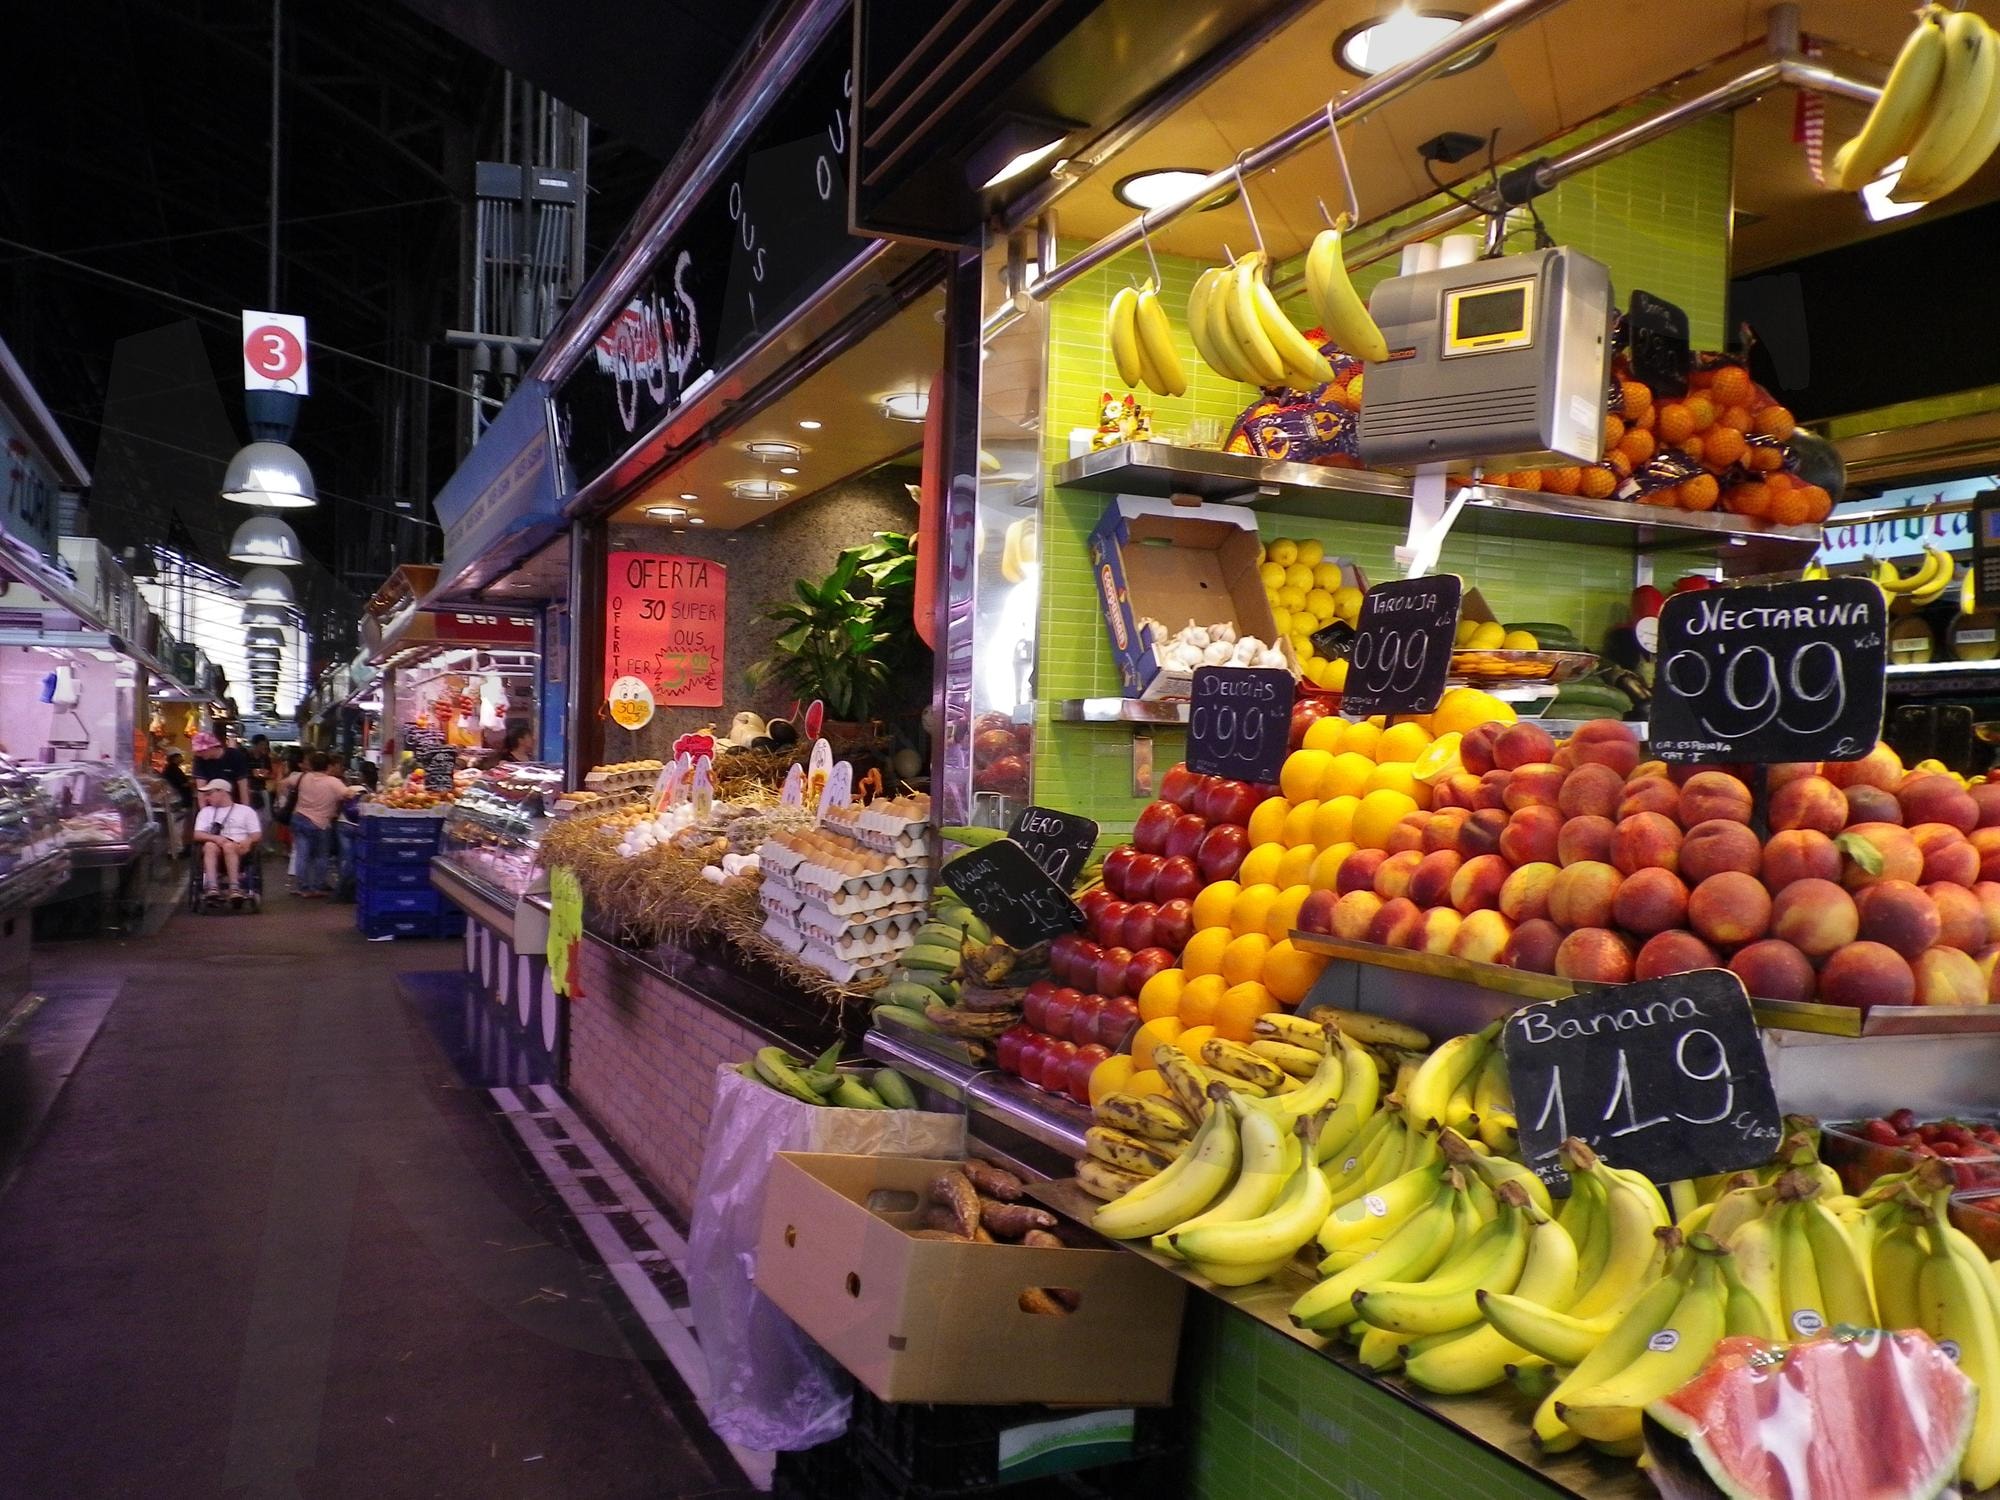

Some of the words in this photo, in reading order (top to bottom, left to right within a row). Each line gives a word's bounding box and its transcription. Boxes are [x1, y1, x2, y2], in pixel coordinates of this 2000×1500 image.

[262, 334, 287, 371] 3
[1822, 490, 1977, 552] ambla
[626, 559, 709, 589] OFERTA
[639, 598, 666, 620] 30
[671, 601, 717, 621] SUPER
[1369, 592, 1438, 614] TARONJA
[612, 596, 623, 679] OFERTA
[674, 629, 705, 646] OUS
[627, 658, 651, 674] PER
[1020, 810, 1064, 837] VERD
[1517, 997, 1712, 1044] Banana
